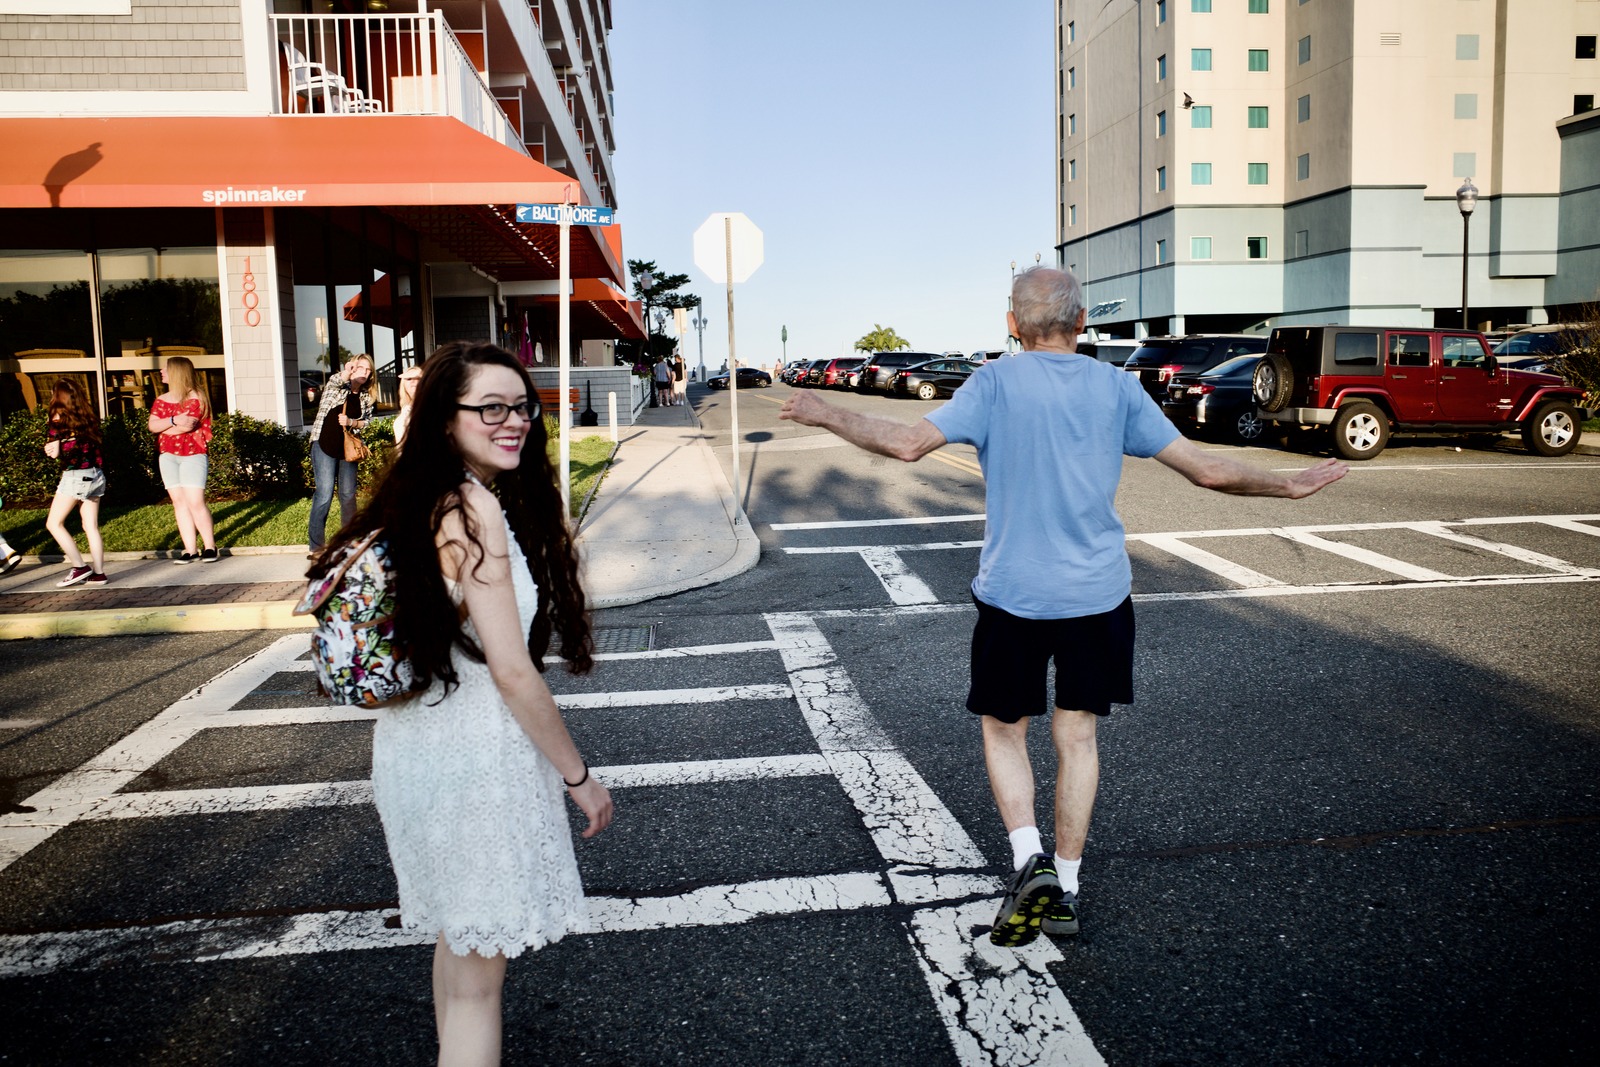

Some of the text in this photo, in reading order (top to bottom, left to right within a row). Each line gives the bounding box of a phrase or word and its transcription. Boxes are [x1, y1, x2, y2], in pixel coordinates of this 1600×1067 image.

[202, 186, 307, 206] spinnaker
[532, 205, 611, 224] BALTIMORE AVE
[242, 255, 261, 327] 1800
